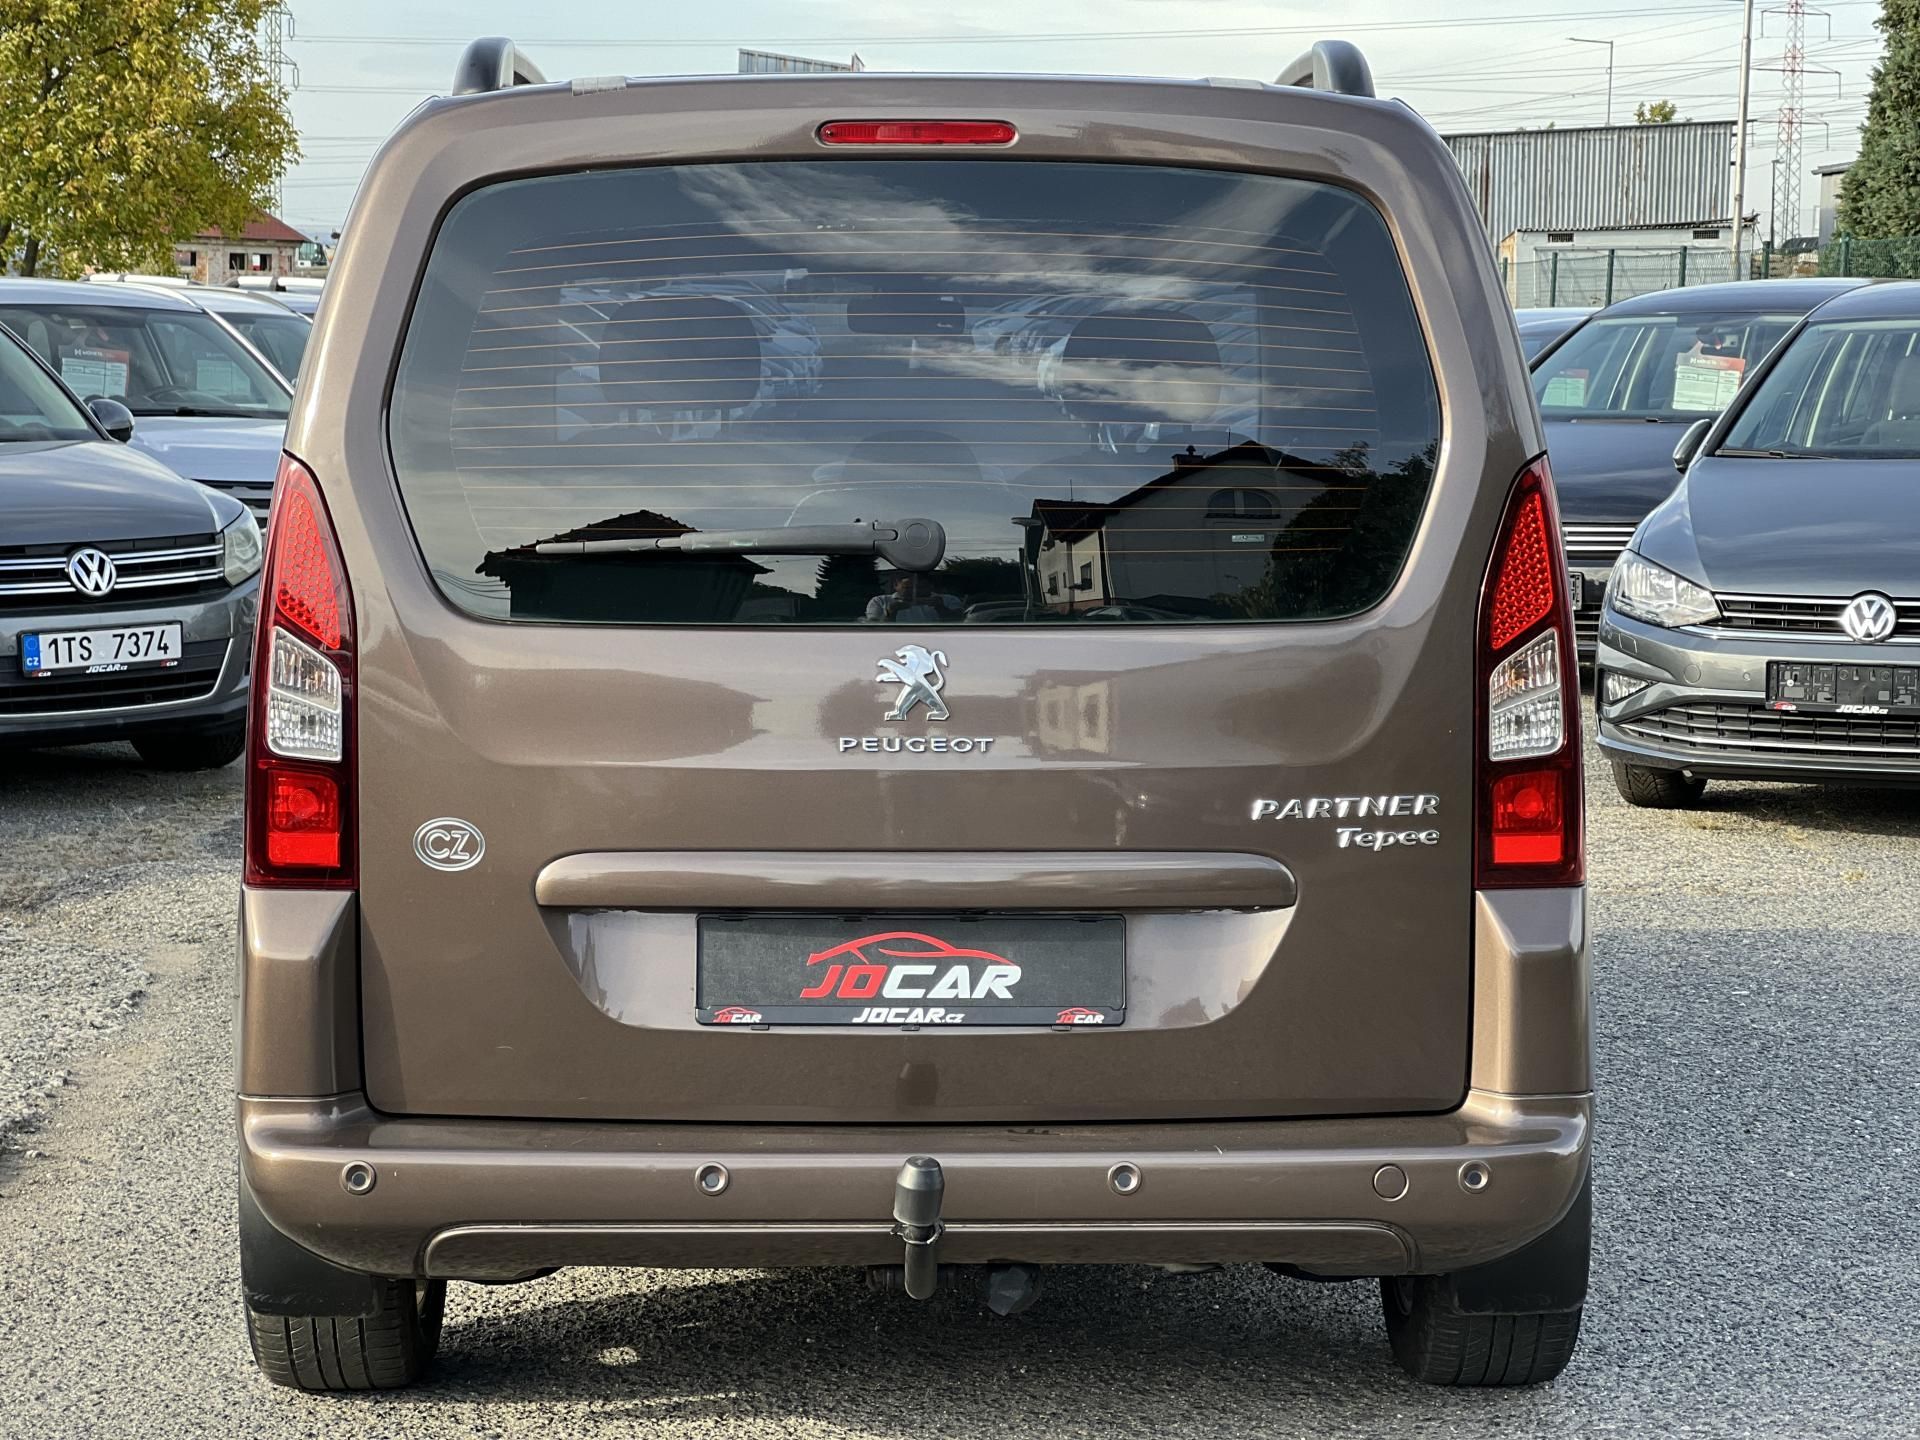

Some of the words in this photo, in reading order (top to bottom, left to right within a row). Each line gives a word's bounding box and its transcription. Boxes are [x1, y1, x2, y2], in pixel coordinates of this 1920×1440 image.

[48, 636, 92, 664] 1TS
[112, 630, 169, 660] 7374
[26, 657, 39, 666] CZ
[839, 737, 994, 752] PEUGEOT
[1251, 794, 1440, 820] PARTNER
[424, 828, 470, 860] CZ
[1336, 827, 1440, 852] Tepee
[800, 964, 1022, 999] JOCAR
[712, 1013, 763, 1024] JOCAR
[852, 1007, 966, 1024] JOCAR.cz
[1055, 1013, 1105, 1024] JOCAR
